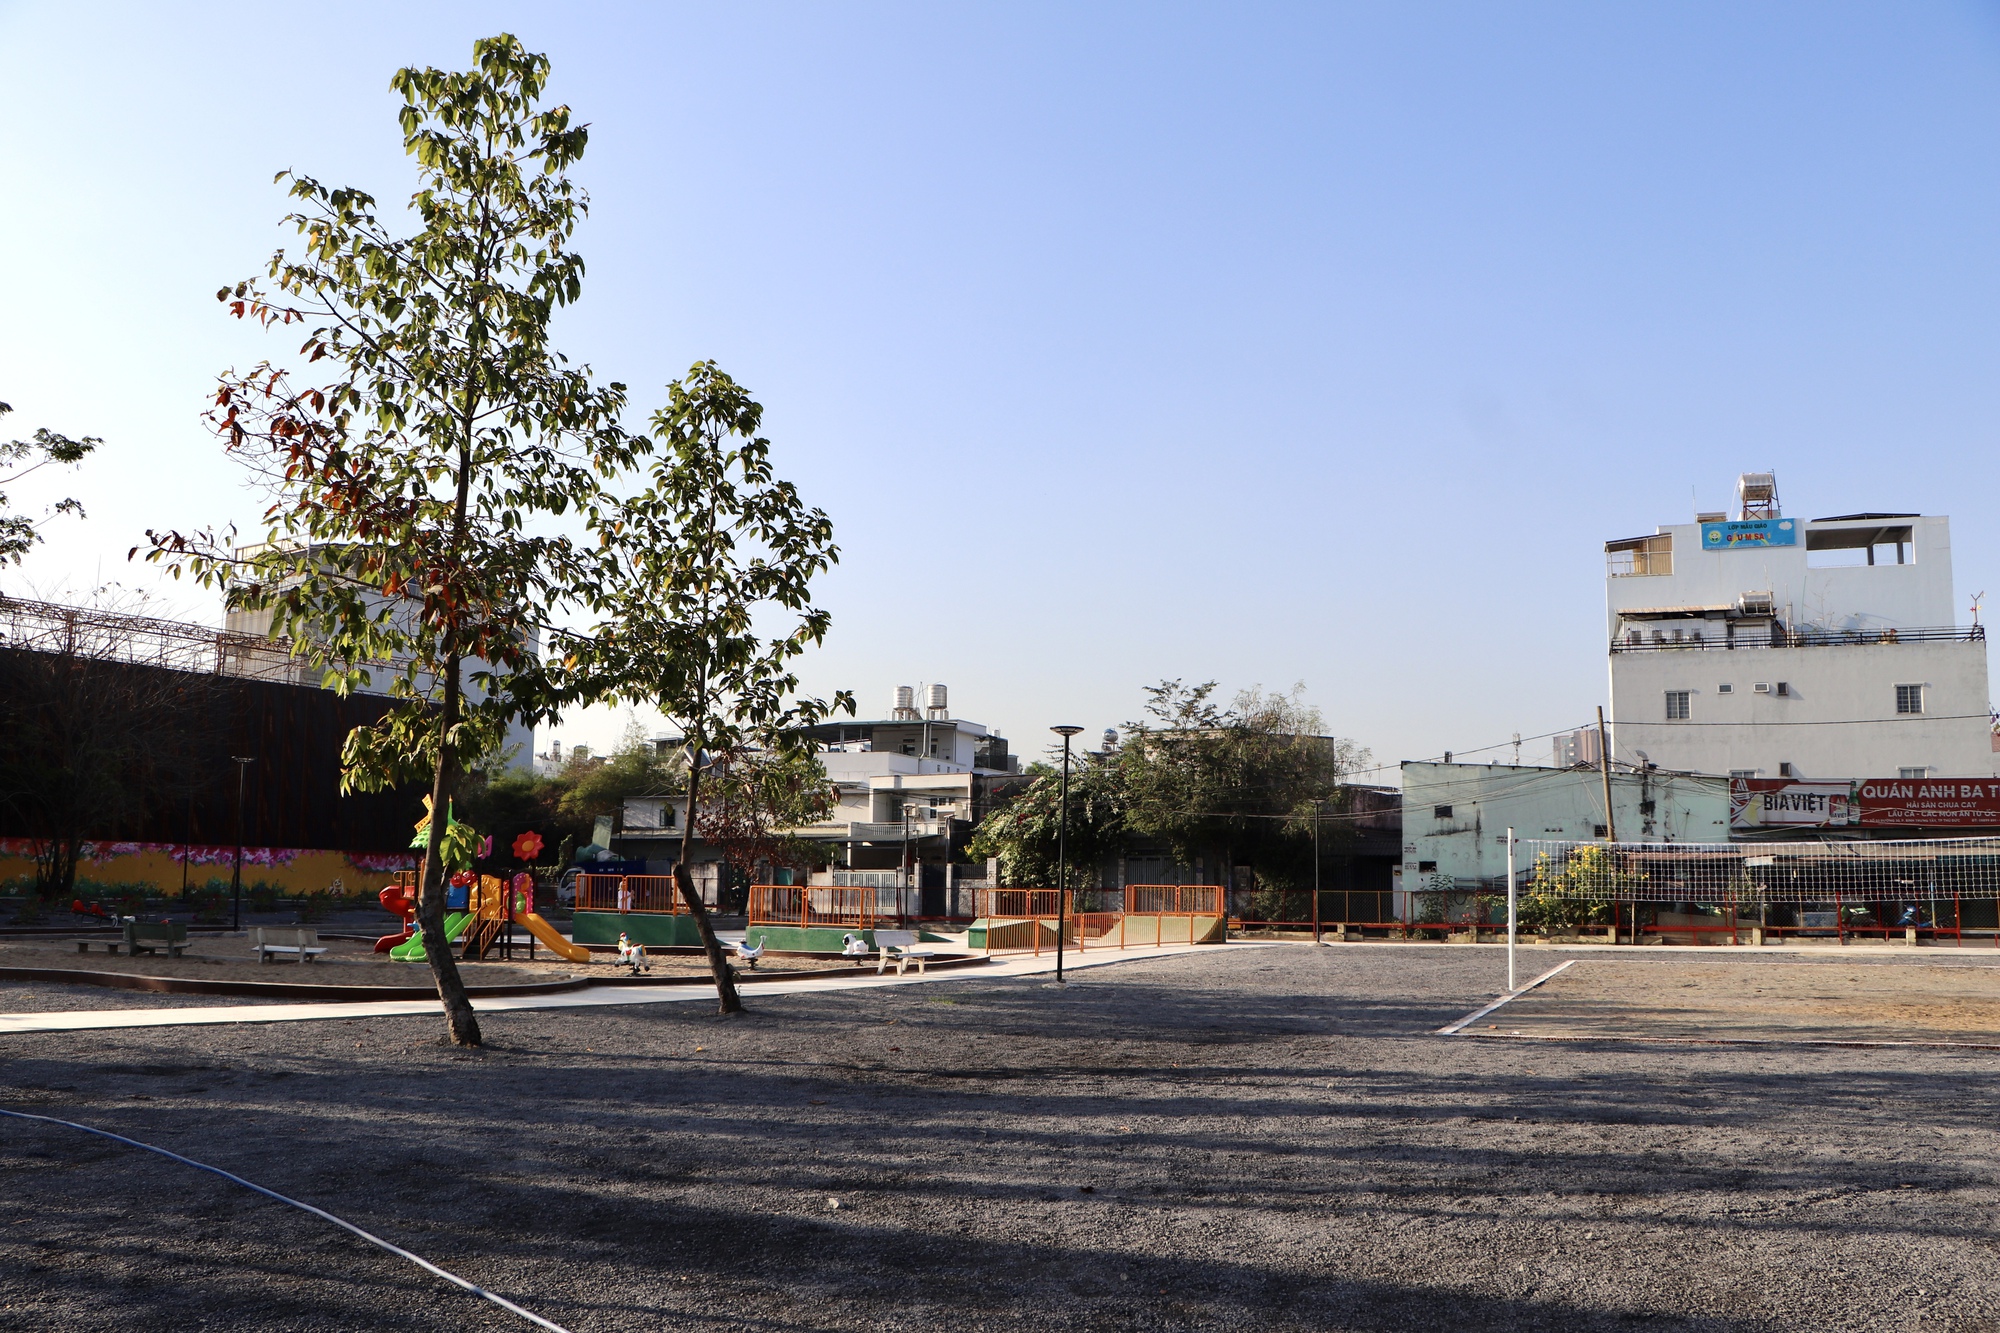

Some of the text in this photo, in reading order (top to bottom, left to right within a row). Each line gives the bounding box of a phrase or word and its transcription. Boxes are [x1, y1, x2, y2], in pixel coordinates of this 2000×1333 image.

[1862, 782, 1913, 798] QUÁN
[1918, 785, 1956, 798] ANH
[1961, 785, 1984, 798] BA
